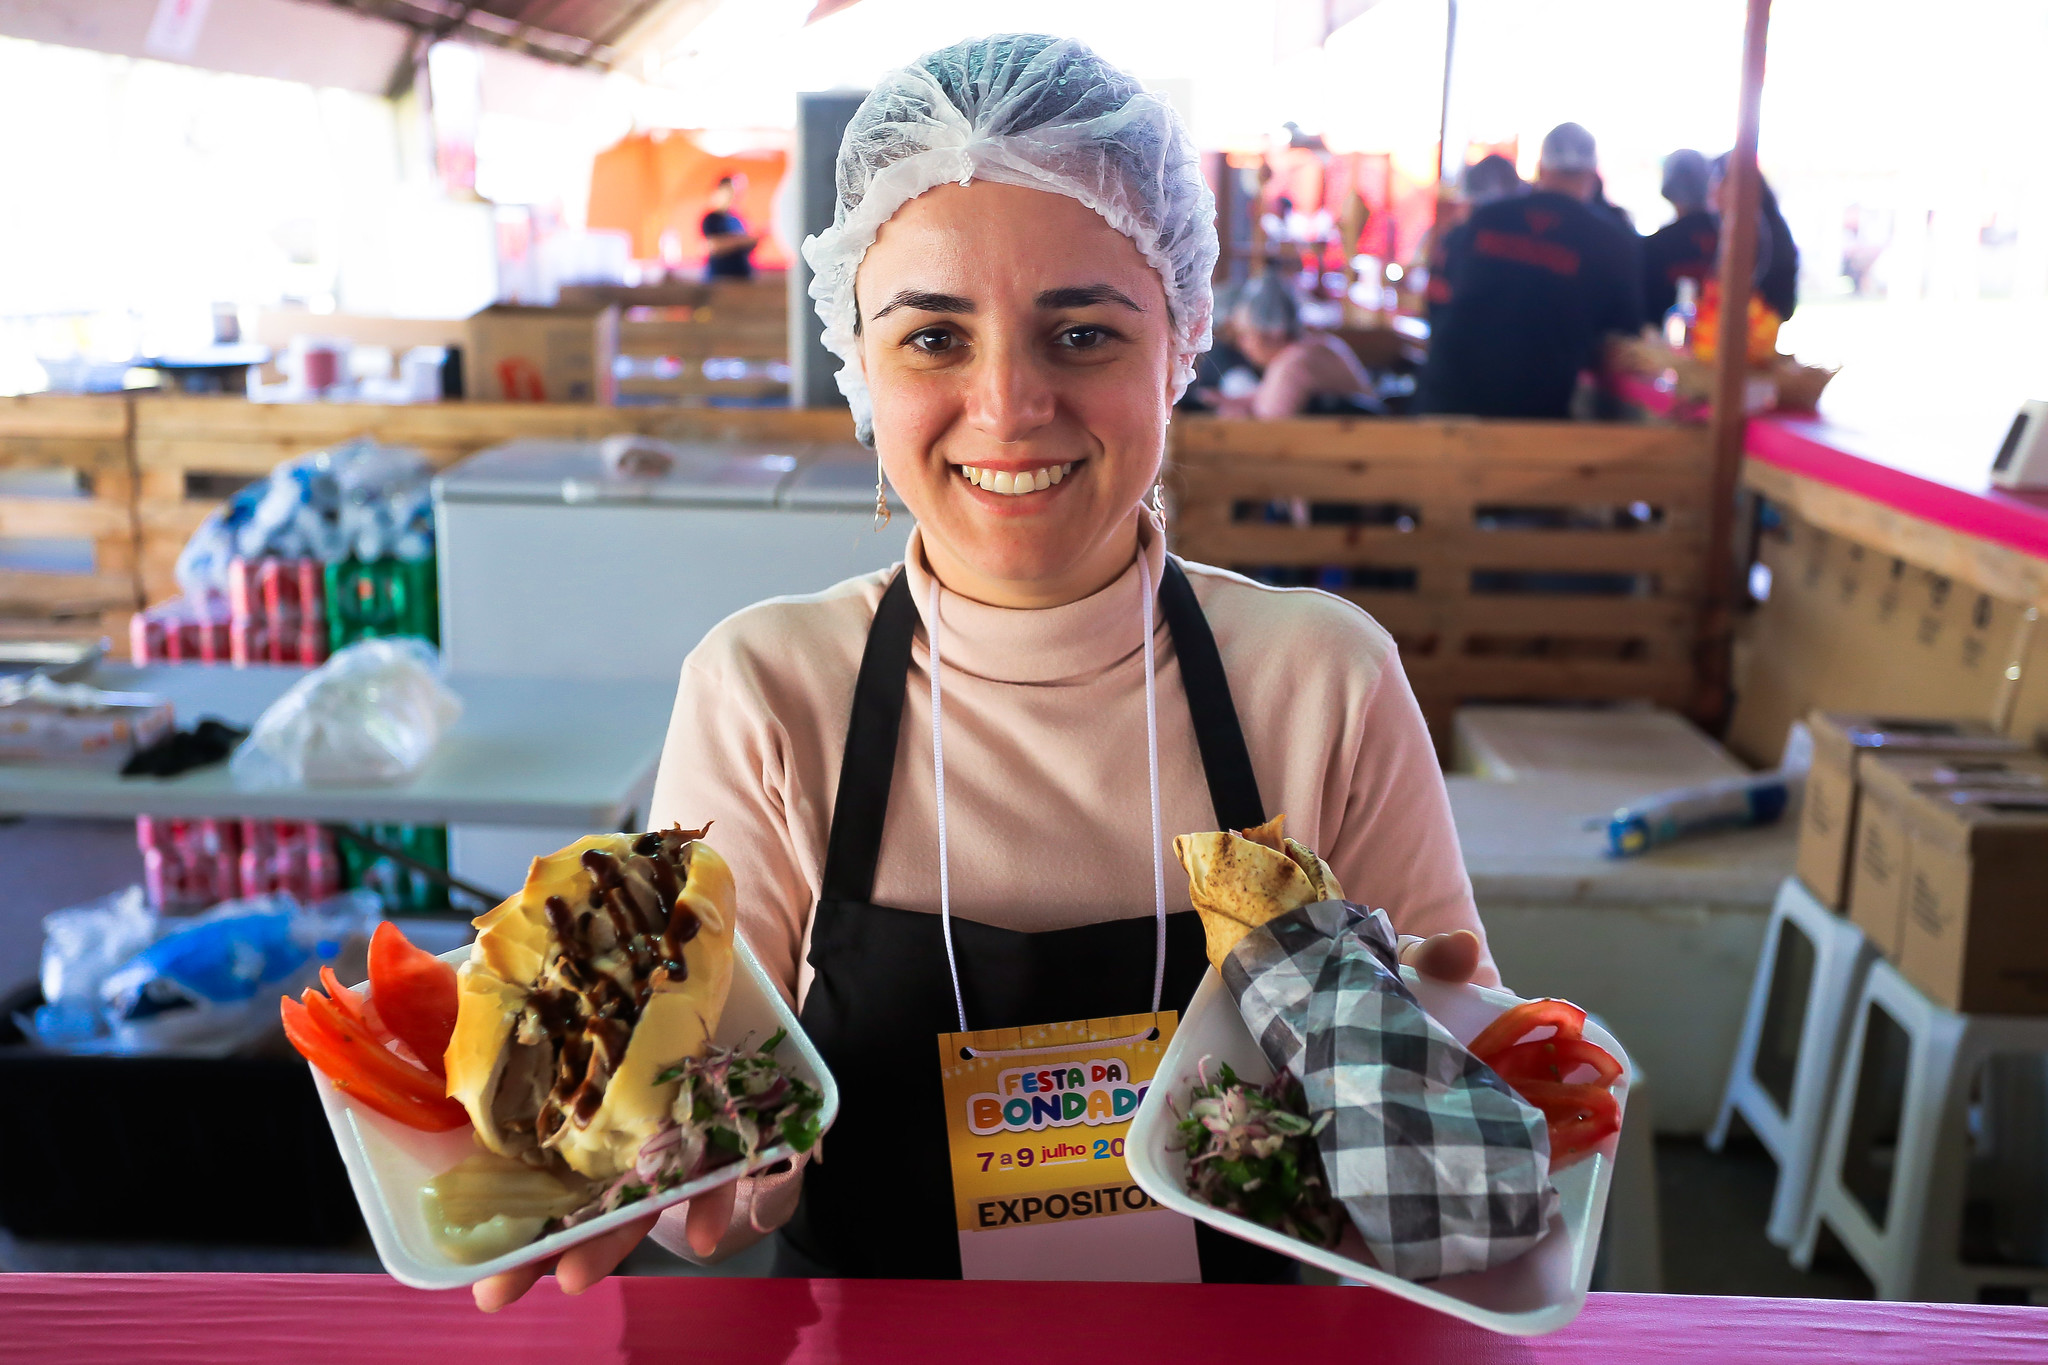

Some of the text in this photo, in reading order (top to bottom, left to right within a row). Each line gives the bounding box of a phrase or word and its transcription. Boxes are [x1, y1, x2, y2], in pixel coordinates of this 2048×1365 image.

[1004, 1064, 1122, 1096] FESTA DA
[976, 1151, 995, 1172] 7
[1000, 1153, 1013, 1166] a
[1016, 1147, 1035, 1168] 9
[1039, 1143, 1087, 1164] julho
[977, 1184, 1158, 1228] EXPOSITO
